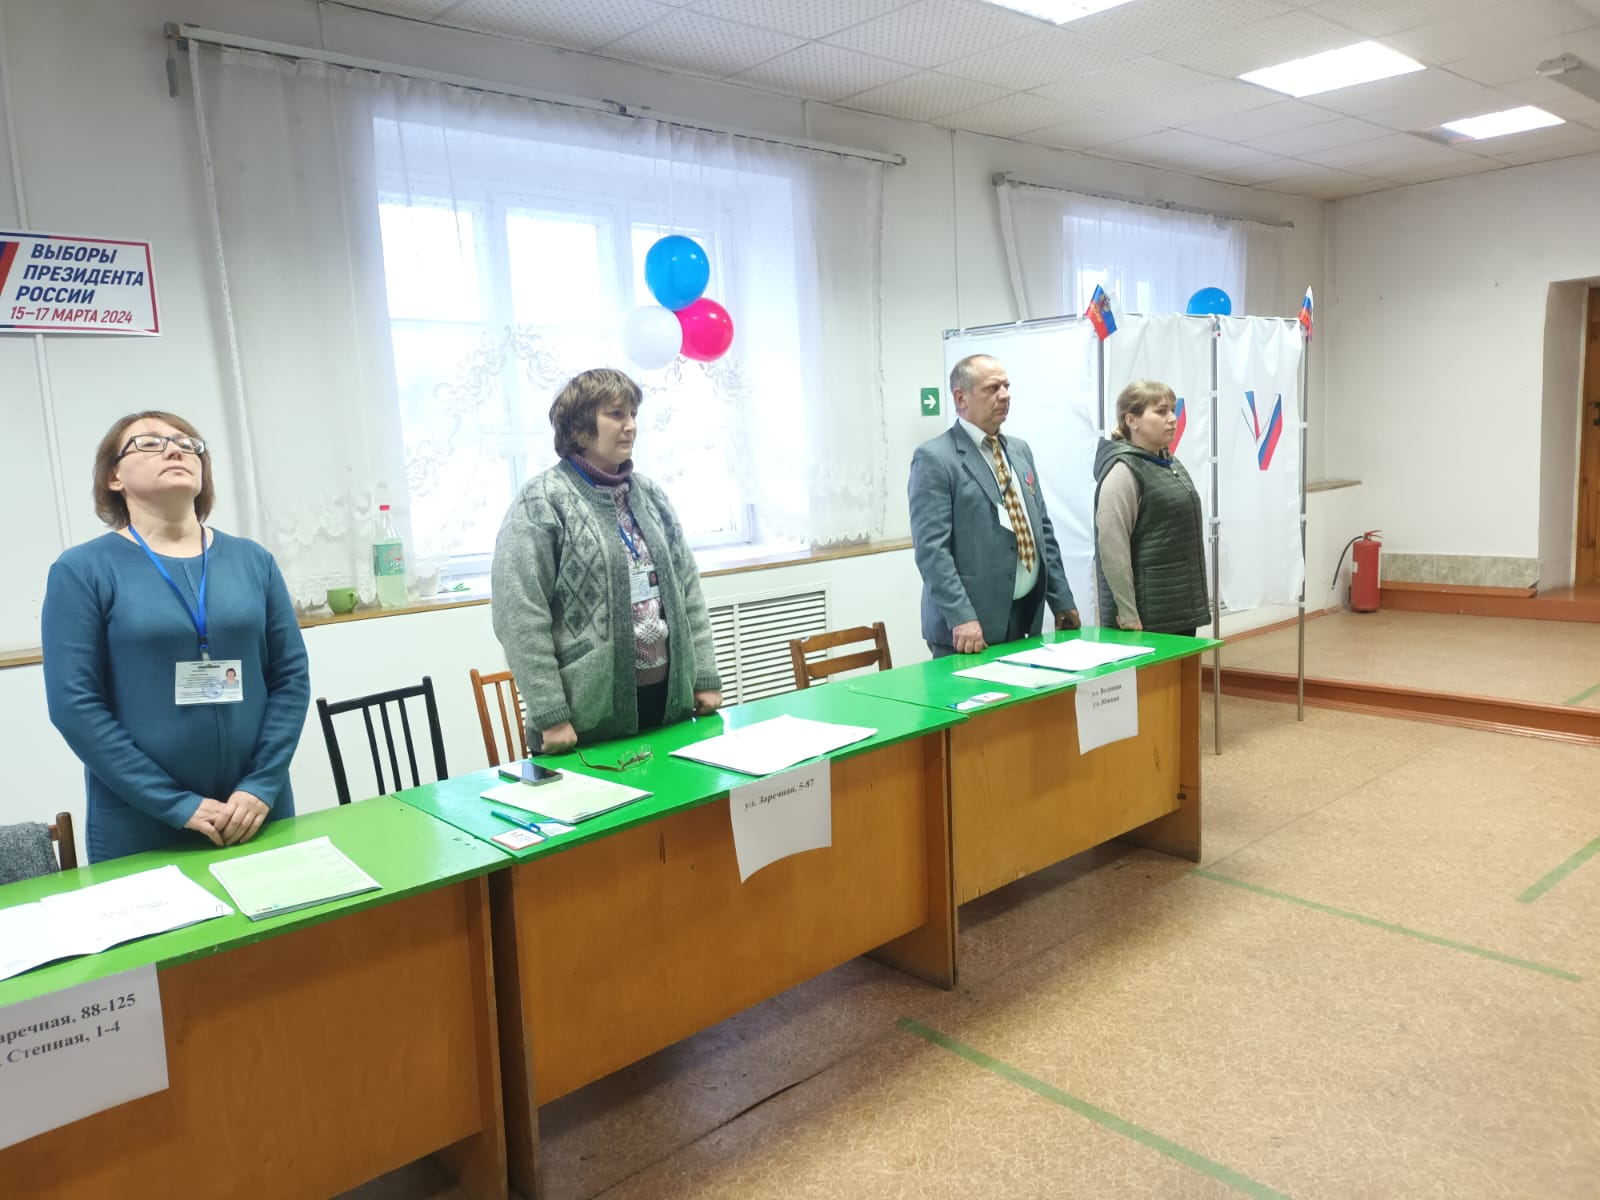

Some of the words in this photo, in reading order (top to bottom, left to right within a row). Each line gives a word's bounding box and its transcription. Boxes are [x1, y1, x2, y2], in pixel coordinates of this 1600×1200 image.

[31, 243, 118, 264] ВЫБОРЫ
[23, 264, 144, 287] ПРЕЗИДЕНТА
[15, 285, 96, 304] РОССИИ
[51, 307, 99, 323] МАРТА
[101, 310, 133, 324] 2024
[81, 993, 136, 1020] 88-125
[6, 1033, 91, 1064] Степная,
[96, 1020, 121, 1038] 1-4
